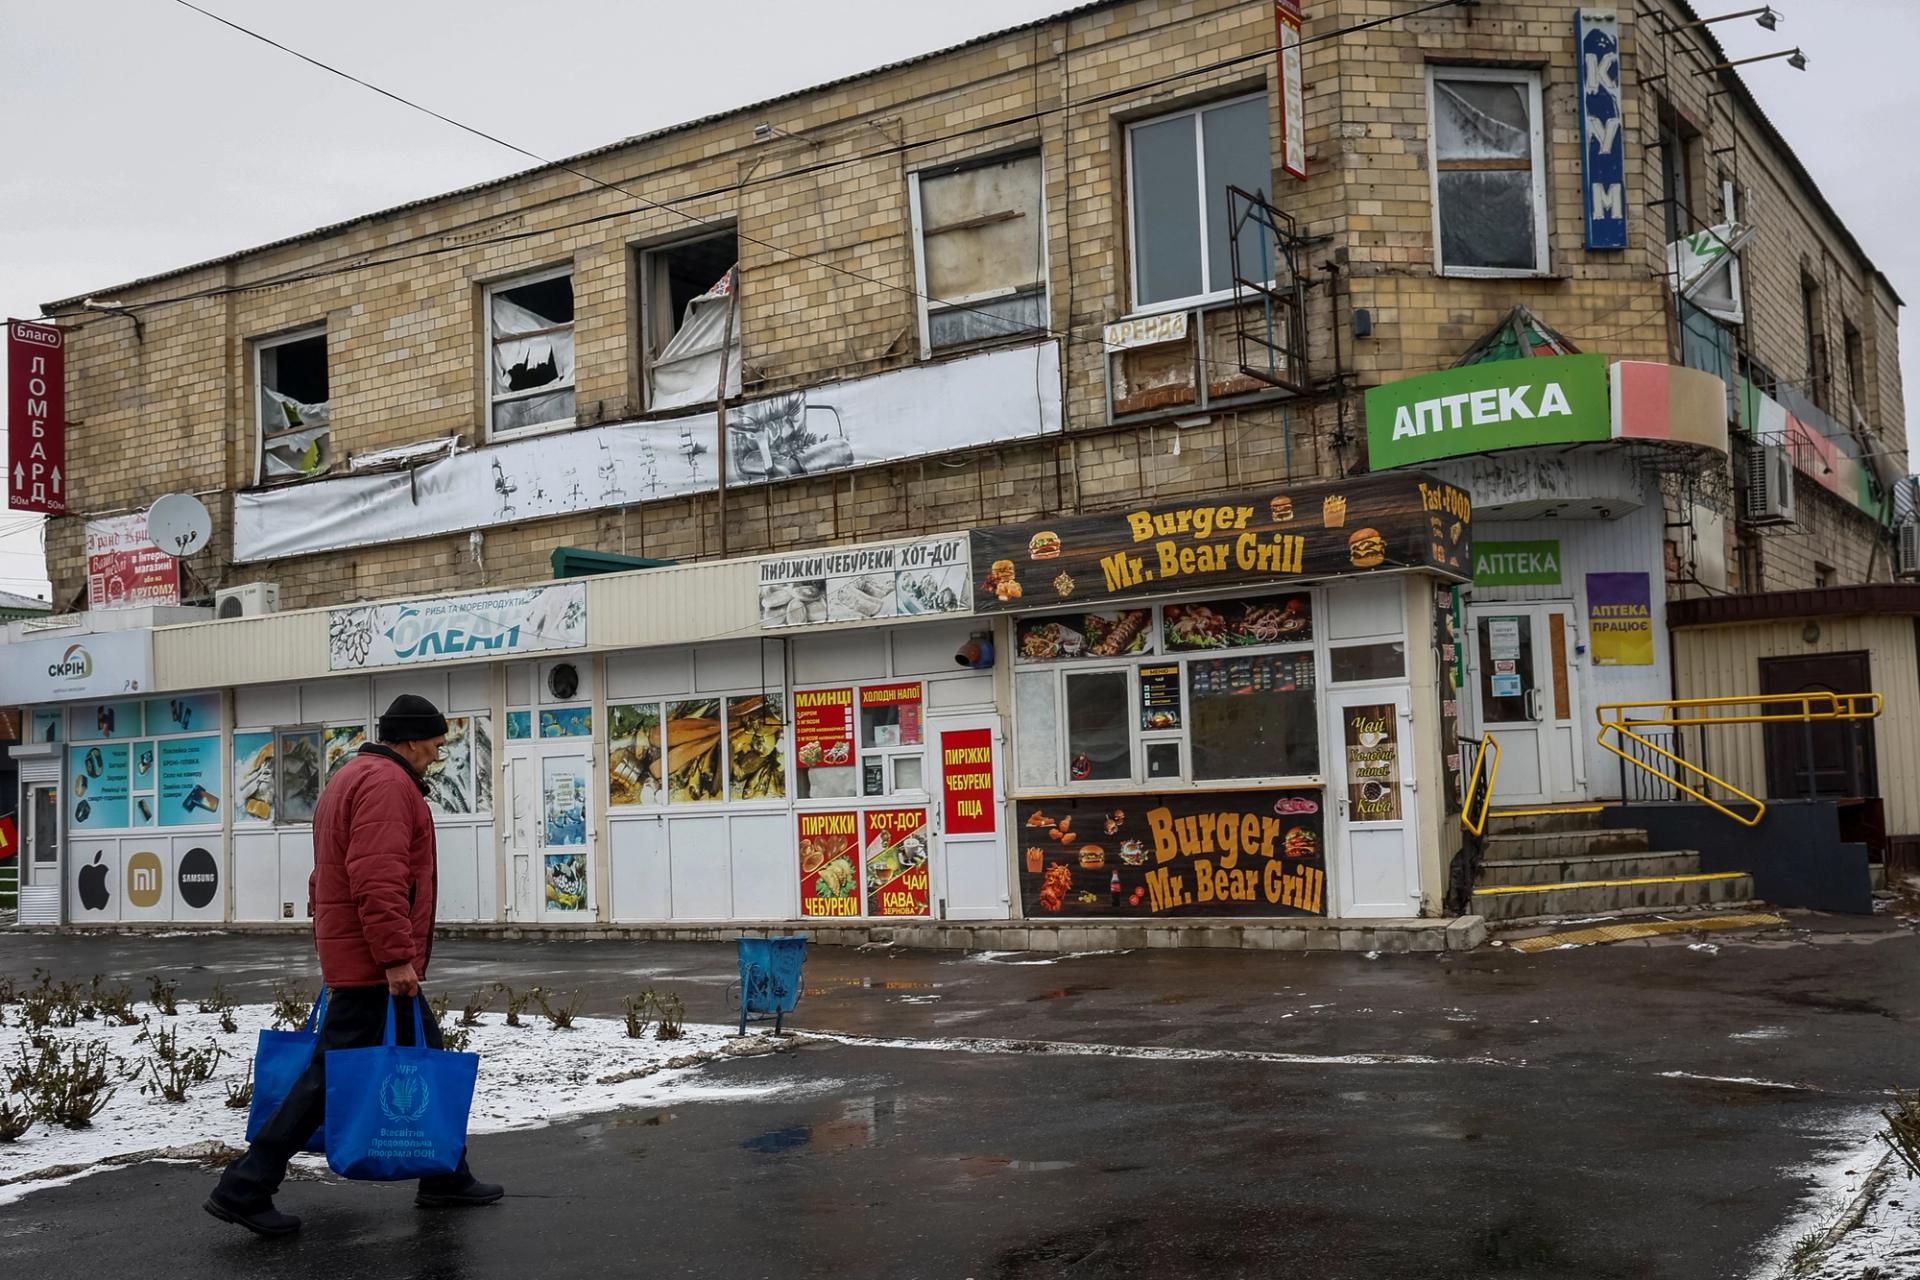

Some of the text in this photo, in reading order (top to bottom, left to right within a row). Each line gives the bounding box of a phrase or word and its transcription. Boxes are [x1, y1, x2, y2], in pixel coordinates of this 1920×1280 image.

[17, 325, 56, 344] Благо
[1108, 316, 1184, 344] АРЕНДА
[1392, 382, 1573, 441] АПТЕКА
[27, 356, 47, 504] ЛОМБАРД
[1127, 503, 1254, 543] Burger
[761, 542, 960, 581] ПИРІЖКИ ЧЕБУРЕКИ ХОТ-ДОГ
[1100, 533, 1305, 593] Mr. Bear Grill
[1476, 552, 1558, 575] АПТЕКА
[425, 605, 446, 616] РИБА
[448, 604, 457, 613] ТА
[1592, 604, 1648, 617] АПТЕКА
[1592, 621, 1648, 633] ПРАЦЮЄ
[48, 662, 85, 677] СКРІН
[796, 690, 852, 707] МЛИНЦІ
[863, 686, 920, 703] ХОЛОДНІ НАПОЇ
[1351, 716, 1385, 733] Чай
[945, 747, 991, 766] ПИРІЖКИ
[1350, 748, 1395, 762] Холодні
[1356, 764, 1391, 778] напої
[946, 773, 991, 791] ЧЕБУРЕКИ
[957, 800, 983, 819] ПІЦА
[1357, 799, 1393, 813] Кава
[802, 813, 855, 835] ПИРІЖКИ
[870, 812, 922, 830] ХОТ-ДОГ
[1147, 807, 1280, 868] Burger
[182, 873, 215, 883] SAMSUNG
[903, 871, 927, 890] ЧАЙ
[1145, 859, 1324, 914] Mr. Bear Grill
[805, 897, 857, 916] ЧЕБУРЕКИ
[883, 892, 915, 907] КАВА
[883, 907, 915, 915] ЗЕРНОВА
[395, 1064, 418, 1074] WFP
